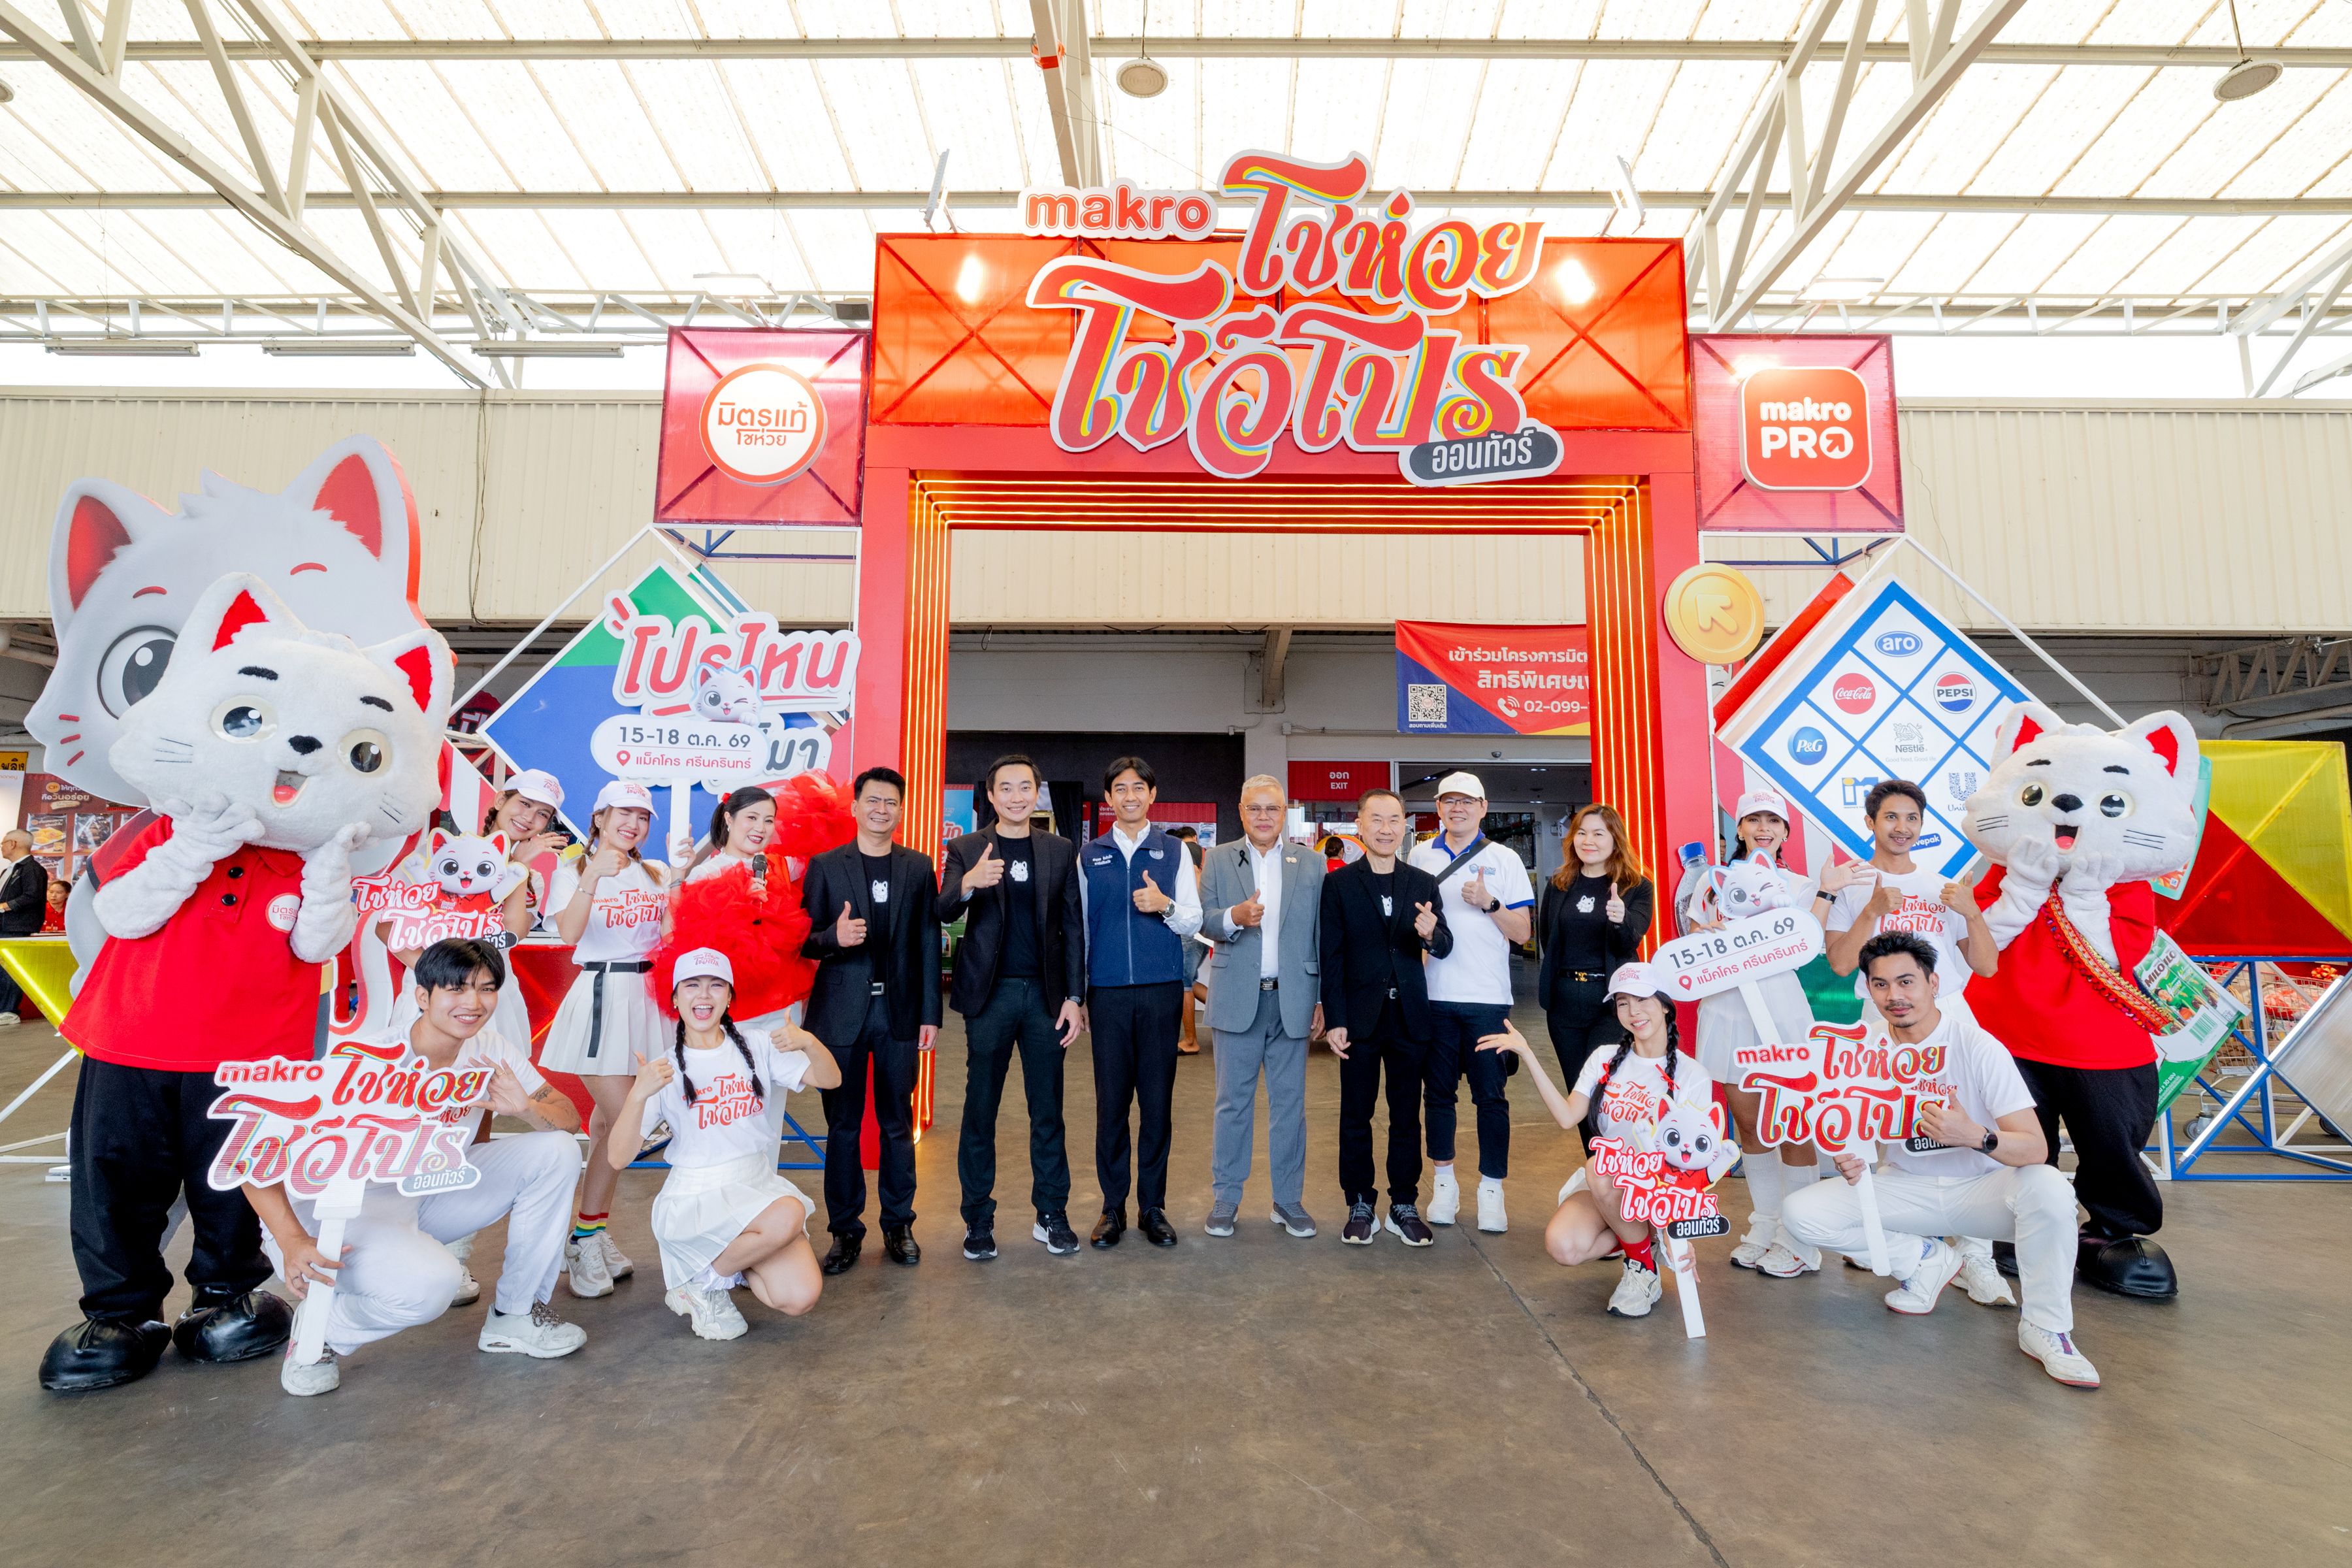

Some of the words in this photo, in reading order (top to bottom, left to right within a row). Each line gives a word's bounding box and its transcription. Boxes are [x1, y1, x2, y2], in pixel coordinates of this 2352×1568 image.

[1026, 185, 1210, 231] makro
[718, 401, 808, 433] มิตรแท้
[1759, 397, 1852, 421] makro
[736, 428, 787, 446] โชห่วย
[1761, 426, 1854, 459] PRO
[1431, 427, 1533, 474] ออนทัวร์
[1882, 636, 1916, 651] aro
[1448, 646, 1588, 662] เข้าร่วมโครงการมิต
[1936, 688, 1974, 698] PEPSI
[1524, 700, 1590, 713] 02-099-
[619, 727, 679, 745] 15-18
[687, 732, 721, 747] ต.ค.
[728, 733, 751, 748] 69
[1795, 739, 1823, 753] P&G
[635, 753, 681, 766] แม็คโคร
[685, 757, 752, 770] ศรีนครินทร์
[1329, 771, 1350, 779] ออก
[1948, 803, 1966, 811] Unil
[1910, 834, 1940, 847] avepak
[1669, 938, 1728, 969] 15-18
[1733, 929, 1769, 948] ต.ค.
[1773, 916, 1795, 936] 69
[1696, 963, 1739, 985] แม็คโคร
[1742, 938, 1809, 970] ศรีนครินทร์
[2144, 961, 2165, 988] MILO
[1737, 1044, 1810, 1064] makro
[220, 1063, 324, 1083] makro
[413, 1166, 467, 1190] ออนทัวร์
[1676, 1214, 1721, 1237] ออนทัวร์
